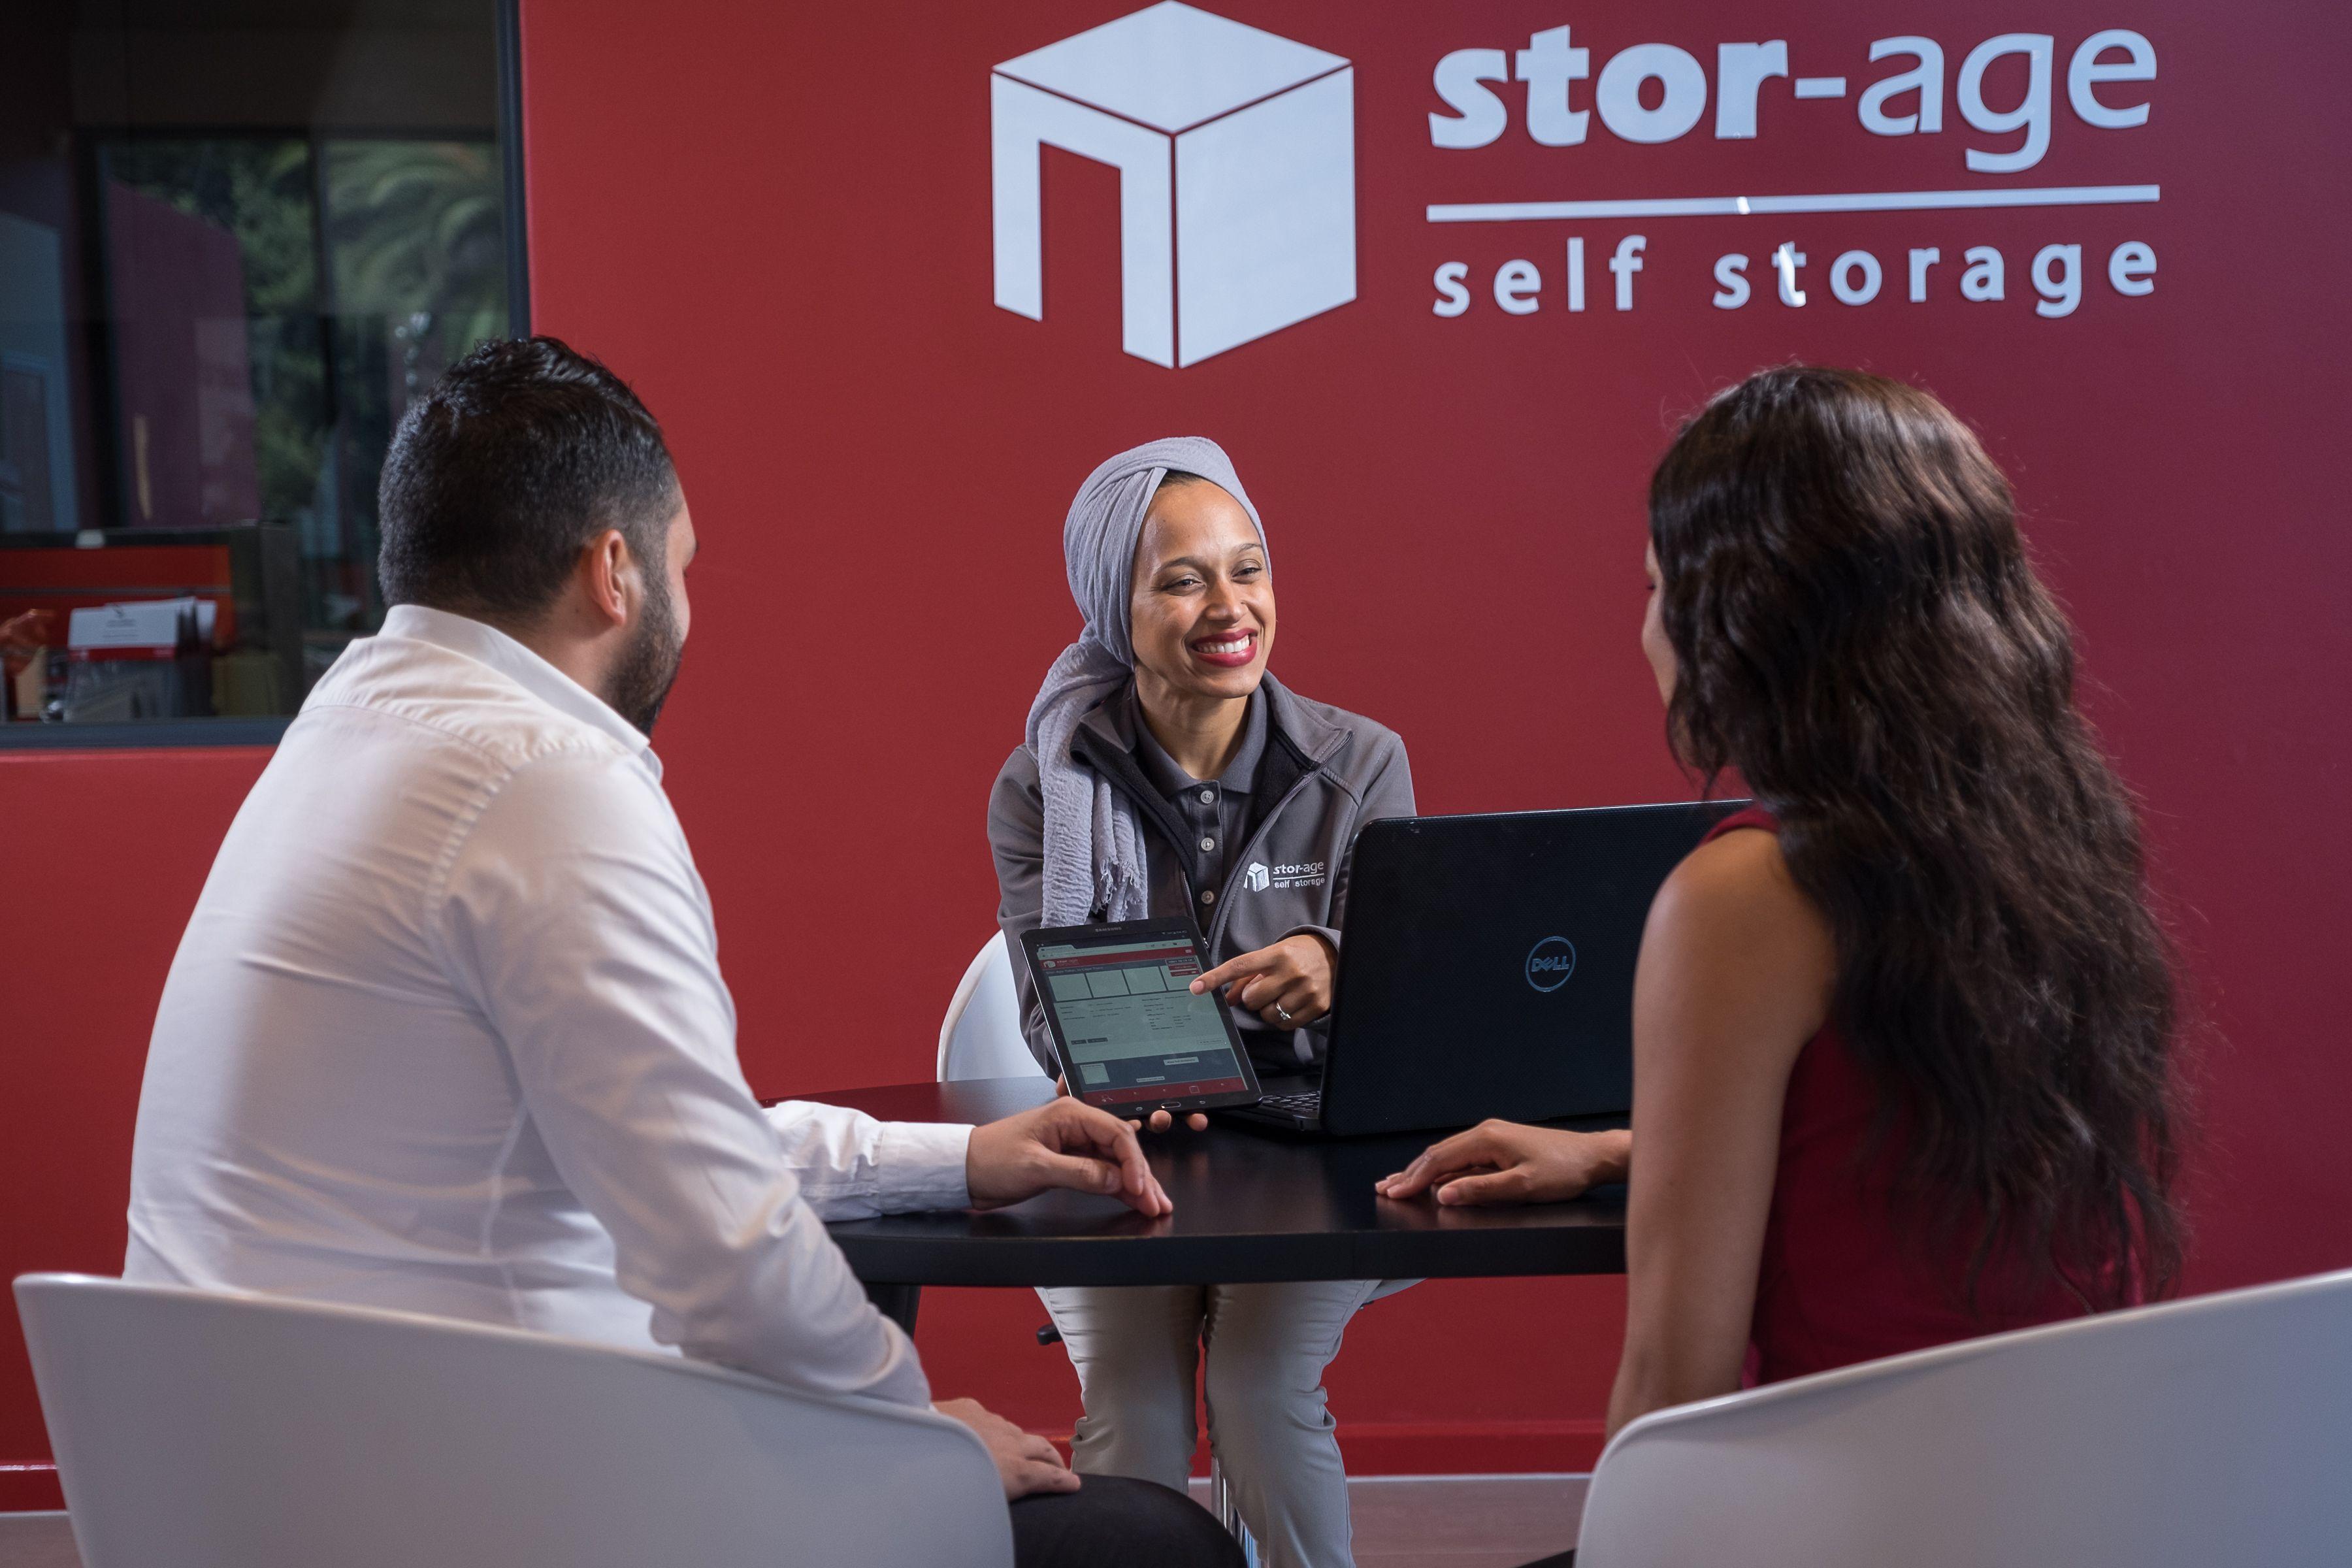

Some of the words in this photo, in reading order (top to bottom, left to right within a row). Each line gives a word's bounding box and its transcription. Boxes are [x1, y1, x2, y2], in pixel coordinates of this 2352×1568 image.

[1428, 25, 2157, 172] stor-age
[1433, 235, 1646, 317] self
[1713, 241, 2157, 318] storage
[1273, 862, 1324, 874] stor-age
[1274, 879, 1290, 889] self
[1295, 877, 1325, 887] storage
[1531, 956, 1569, 972] DELL
